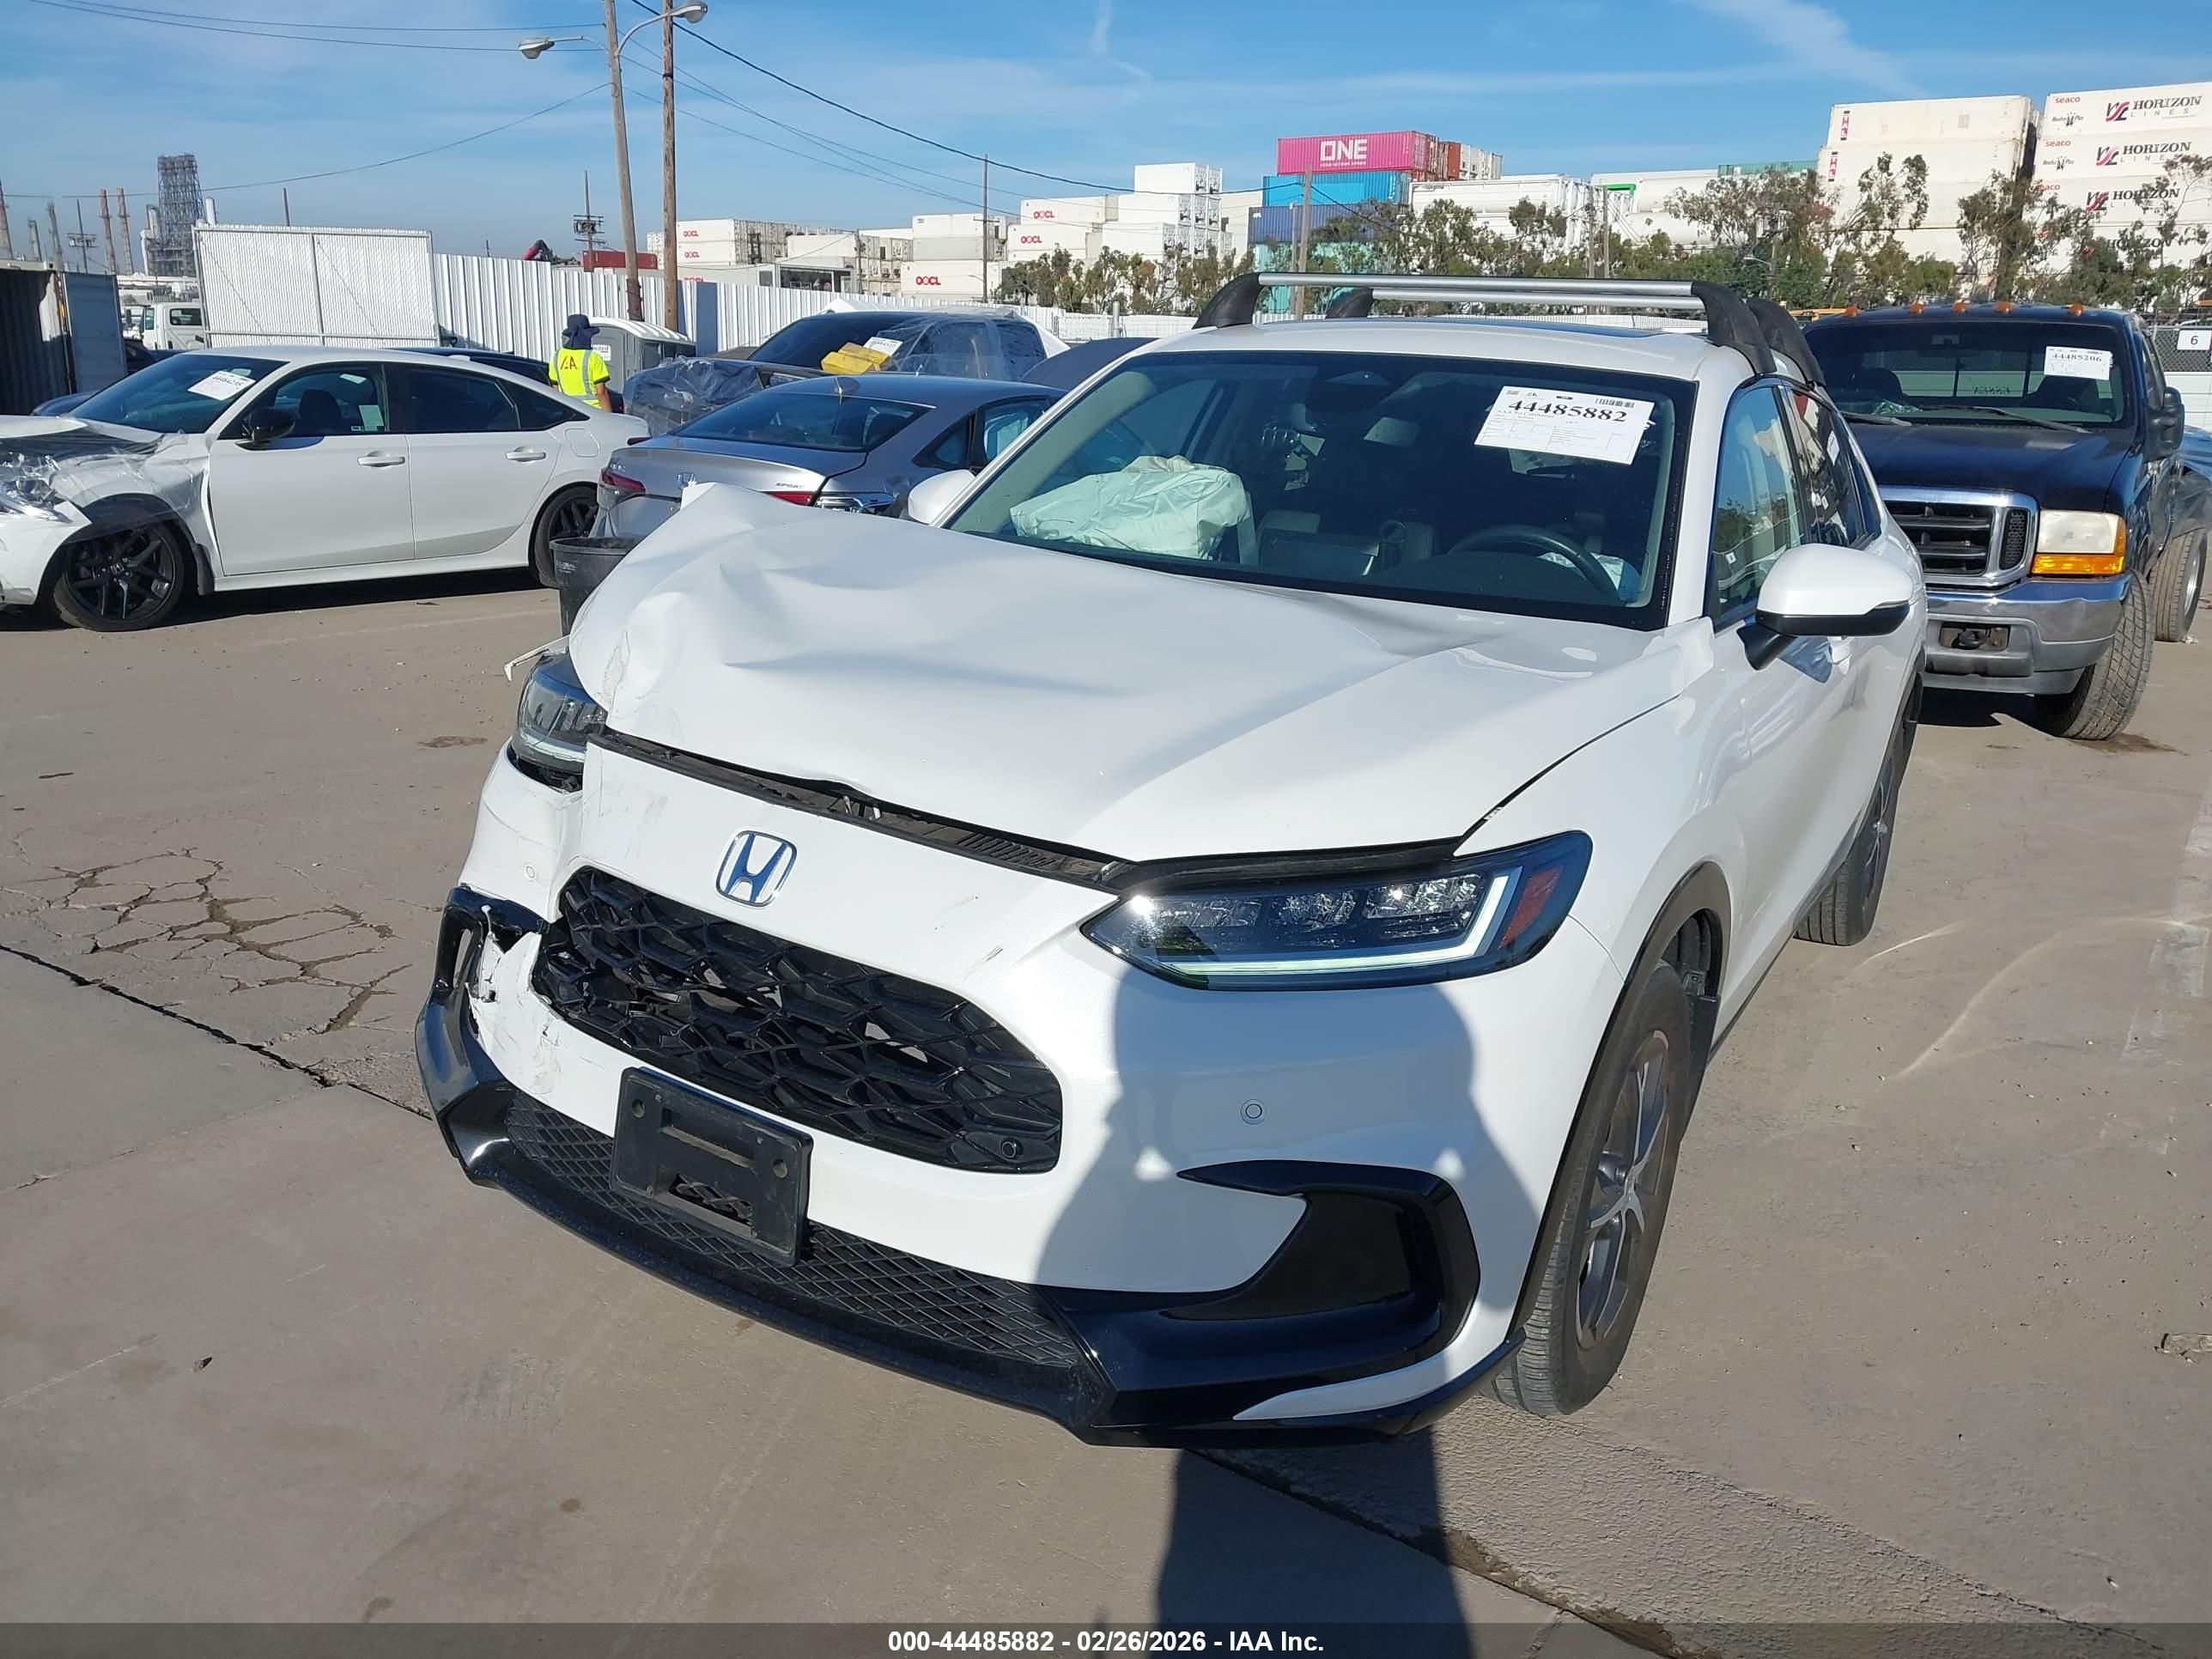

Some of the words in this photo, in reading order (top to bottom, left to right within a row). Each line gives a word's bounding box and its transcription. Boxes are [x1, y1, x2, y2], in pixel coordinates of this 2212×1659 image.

[2132, 95, 2203, 110] HORIZON
[2130, 107, 2190, 118] LINES
[1320, 139, 1368, 161] ONE
[2122, 142, 2192, 155] HORIZON
[1033, 210, 1055, 220] OOCL
[1020, 235, 1042, 244] OOCL
[915, 276, 942, 286] OOCL
[2190, 335, 2199, 345] 6
[1508, 400, 1627, 422] 44485882
